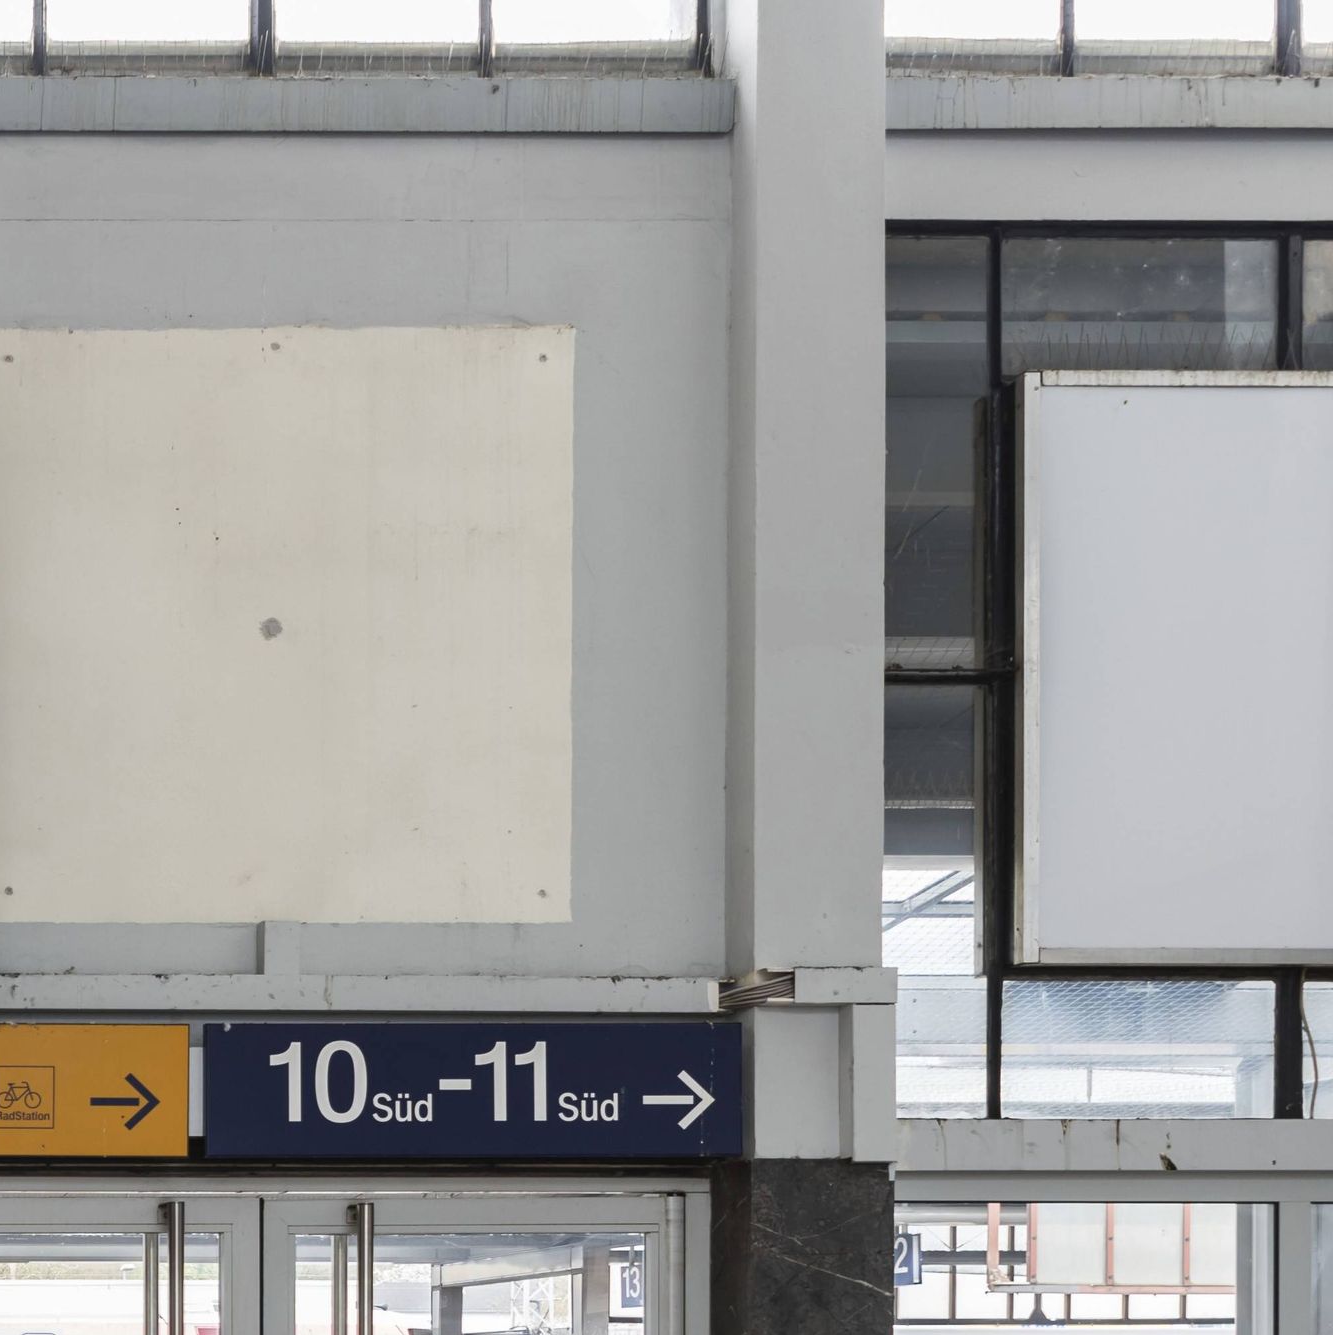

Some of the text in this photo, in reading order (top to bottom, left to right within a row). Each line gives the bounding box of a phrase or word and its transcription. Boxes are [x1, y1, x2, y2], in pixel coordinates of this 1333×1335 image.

[270, 1040, 368, 1123] 10
[372, 1093, 433, 1122] Süd
[558, 1093, 618, 1122] Süd
[623, 1266, 641, 1298] 13
